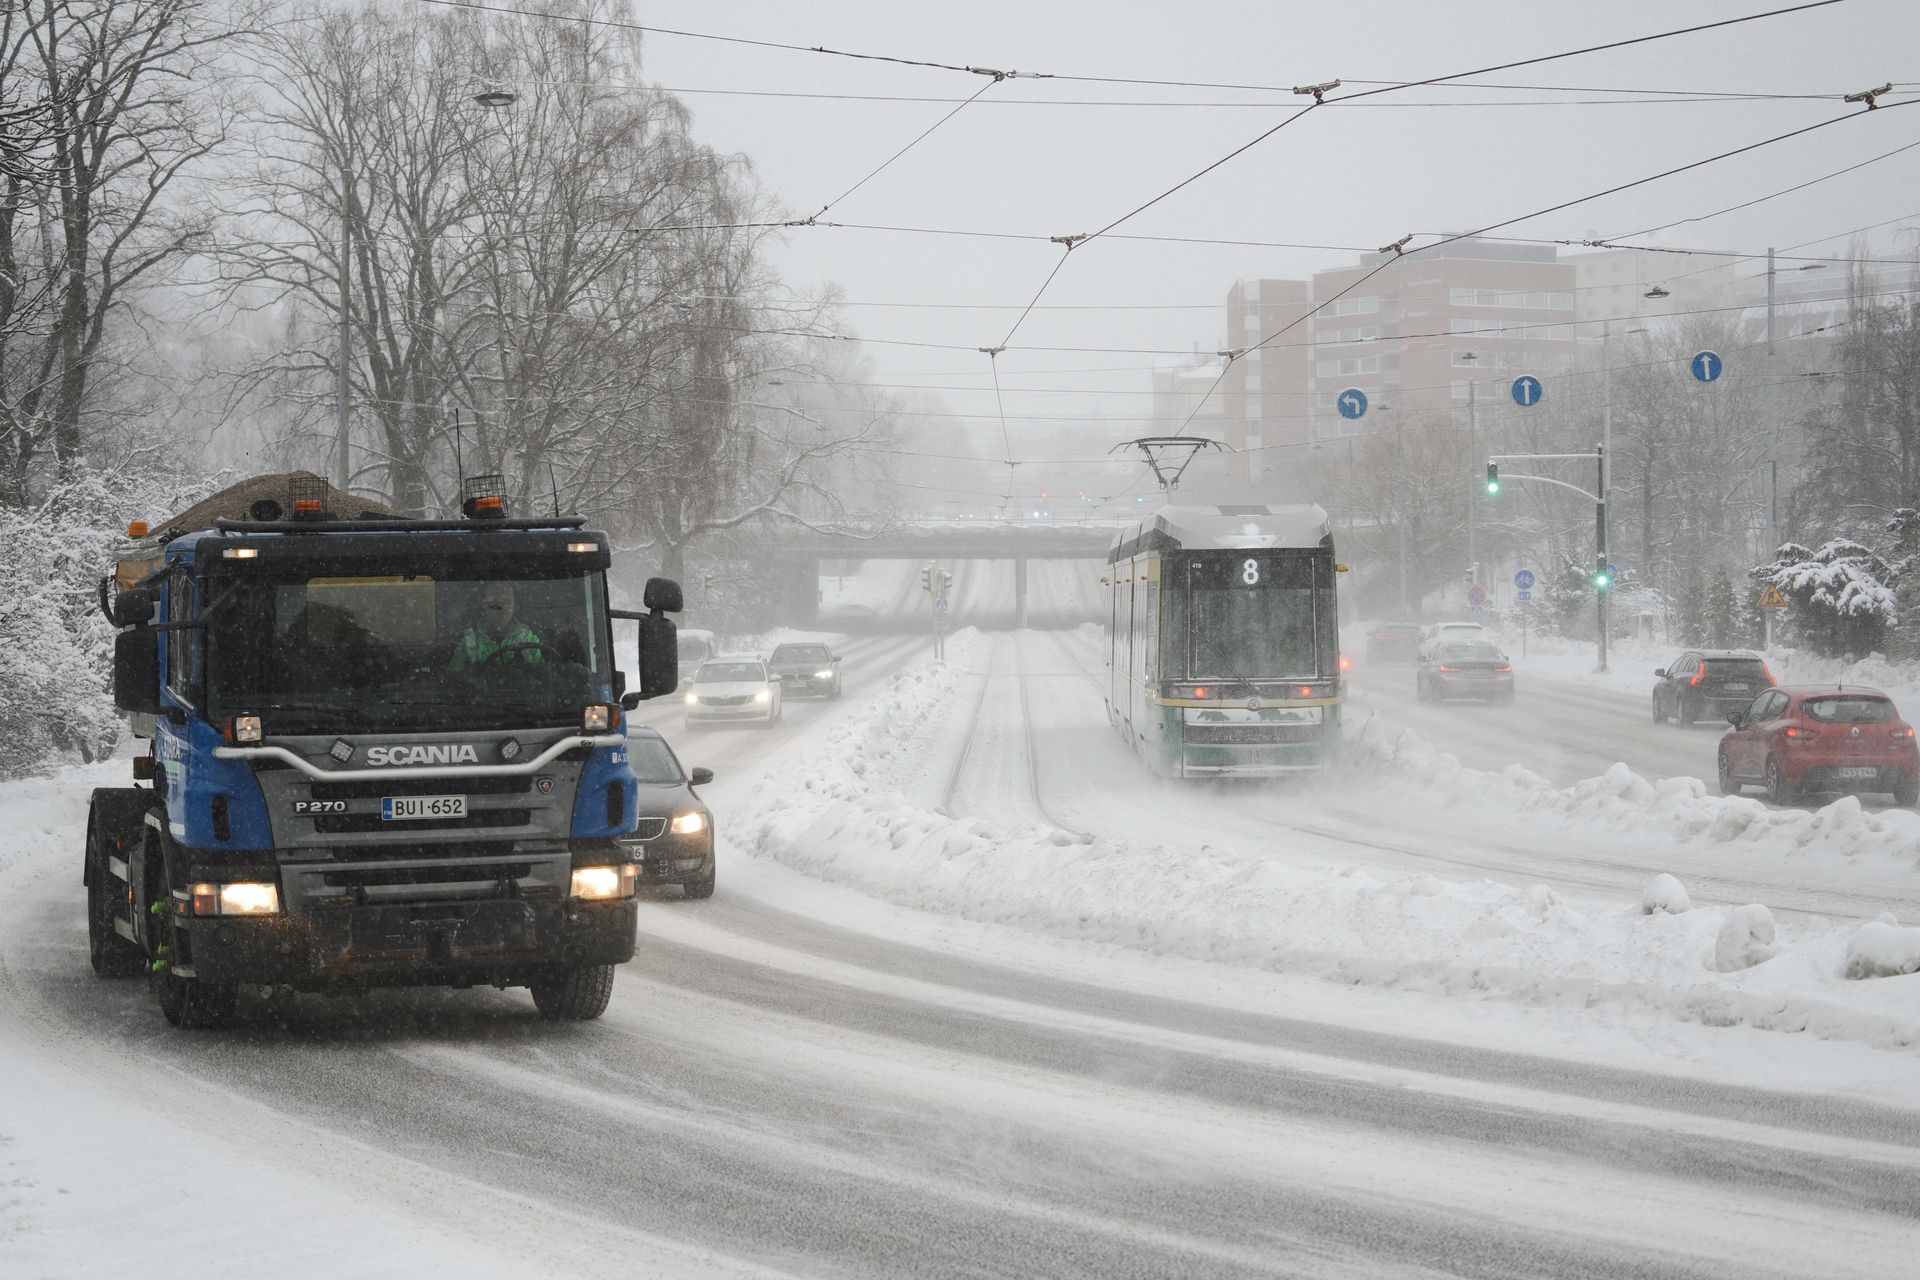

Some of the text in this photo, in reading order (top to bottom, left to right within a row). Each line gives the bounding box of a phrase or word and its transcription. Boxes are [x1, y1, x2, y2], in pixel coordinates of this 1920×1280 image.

[1243, 558, 1259, 585] 8
[367, 744, 479, 766] SCANIA
[296, 801, 346, 812] P 270
[395, 798, 463, 816] BUI-652
